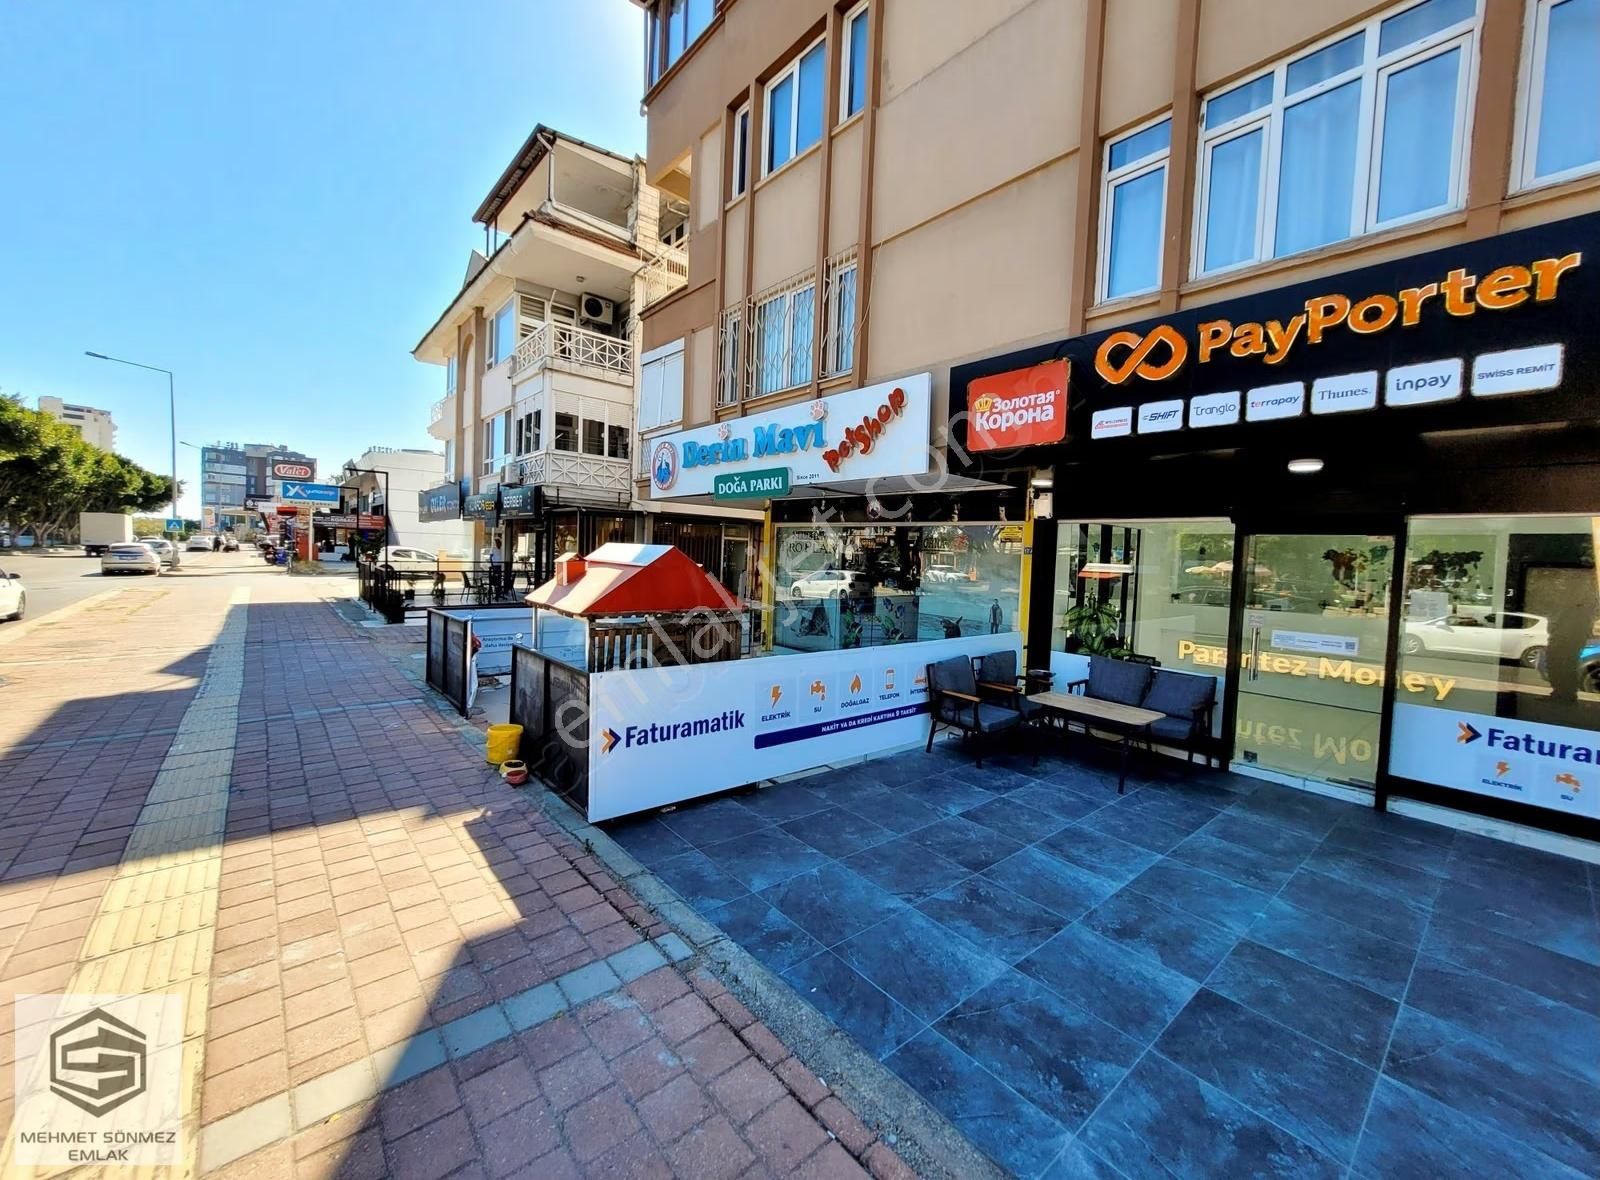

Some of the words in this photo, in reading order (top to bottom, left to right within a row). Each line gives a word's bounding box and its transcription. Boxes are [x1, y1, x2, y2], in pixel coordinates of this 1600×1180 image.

[1197, 251, 1582, 365] PayPorter
[1395, 373, 1452, 392] inpay
[992, 389, 1056, 414] Золотая
[1193, 404, 1236, 416] Tranglo
[1250, 396, 1300, 409] terrapay
[975, 404, 1055, 433] Корона
[1149, 410, 1179, 421] SHIFT
[682, 437, 748, 469] Derin
[753, 420, 829, 458] Mavi
[279, 465, 306, 476] Valet
[719, 476, 748, 495] DOĞA
[750, 476, 783, 491] PARKI
[1178, 640, 1308, 677] Parntez
[840, 698, 870, 709] DOĞALGAZ
[879, 692, 900, 701] TELEFON
[761, 710, 791, 722] ELEKTRİK
[625, 709, 745, 748] Faturamatik
